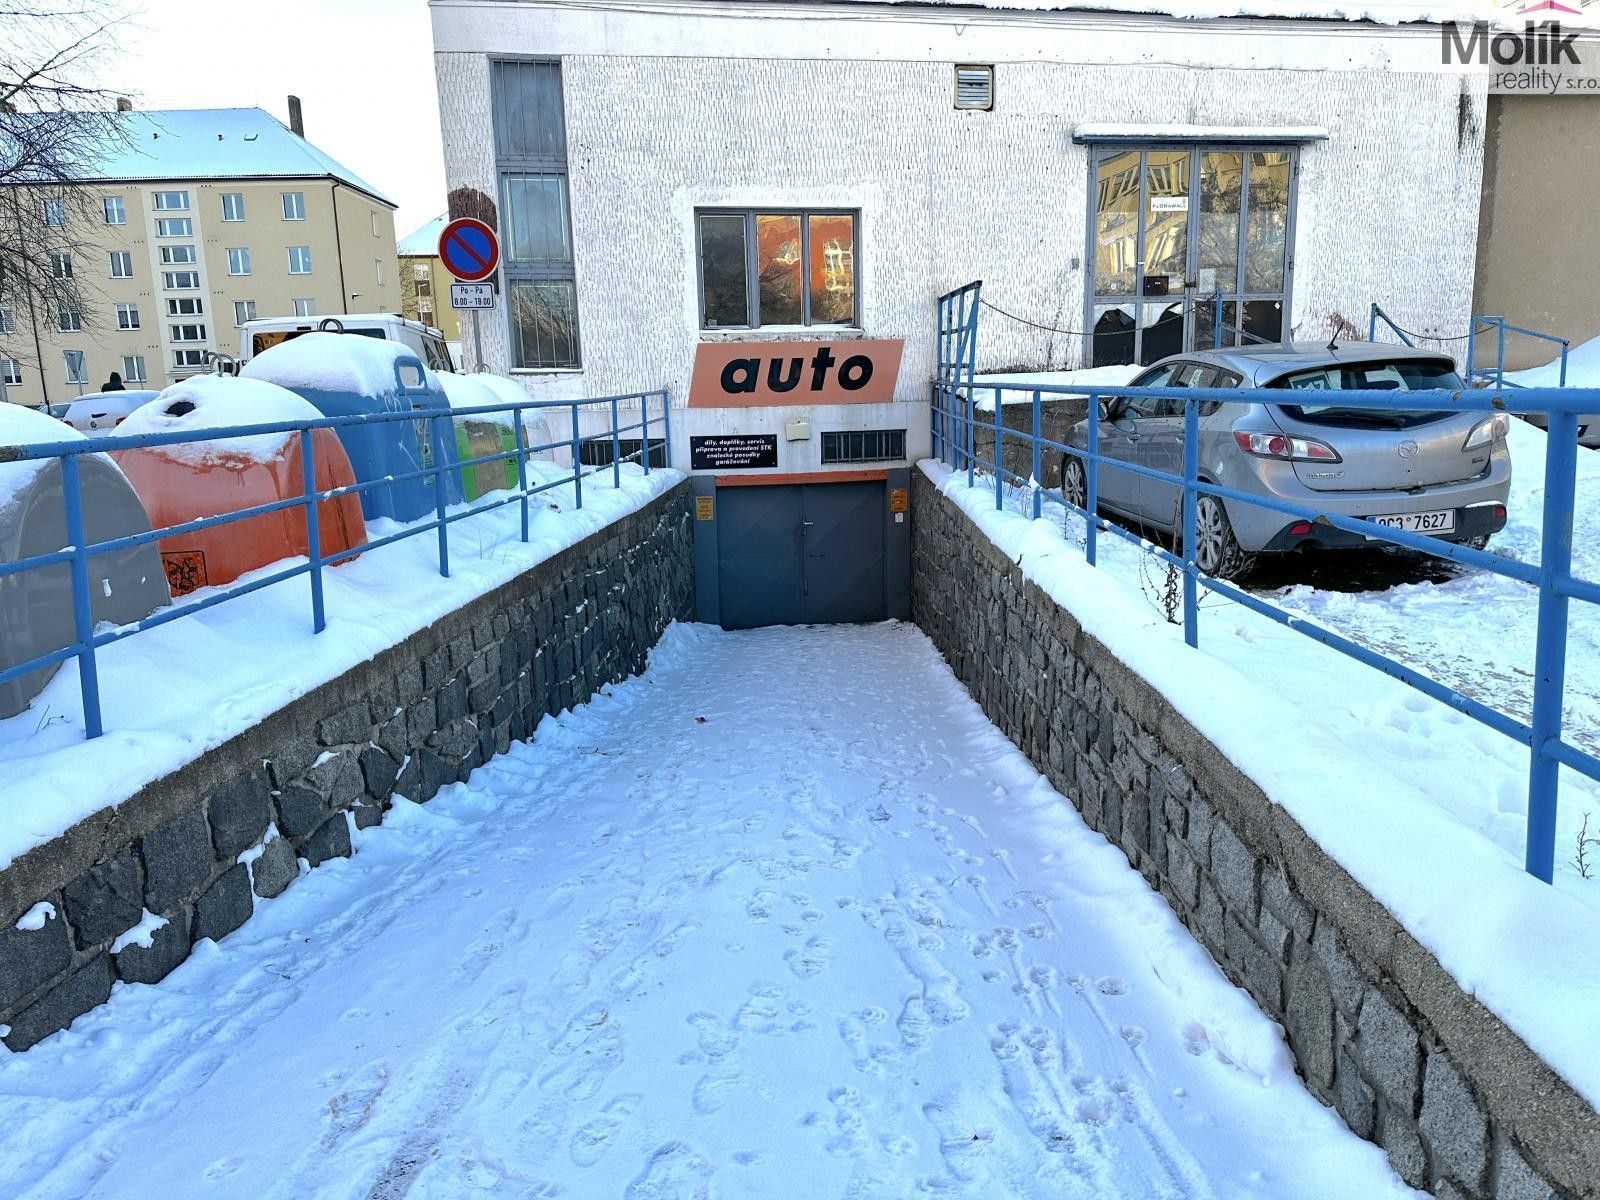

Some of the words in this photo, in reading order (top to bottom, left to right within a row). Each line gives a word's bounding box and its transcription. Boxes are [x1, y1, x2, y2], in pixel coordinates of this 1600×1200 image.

[460, 286, 468, 294] Po
[720, 347, 874, 394] auto
[1414, 513, 1447, 530] 7627
